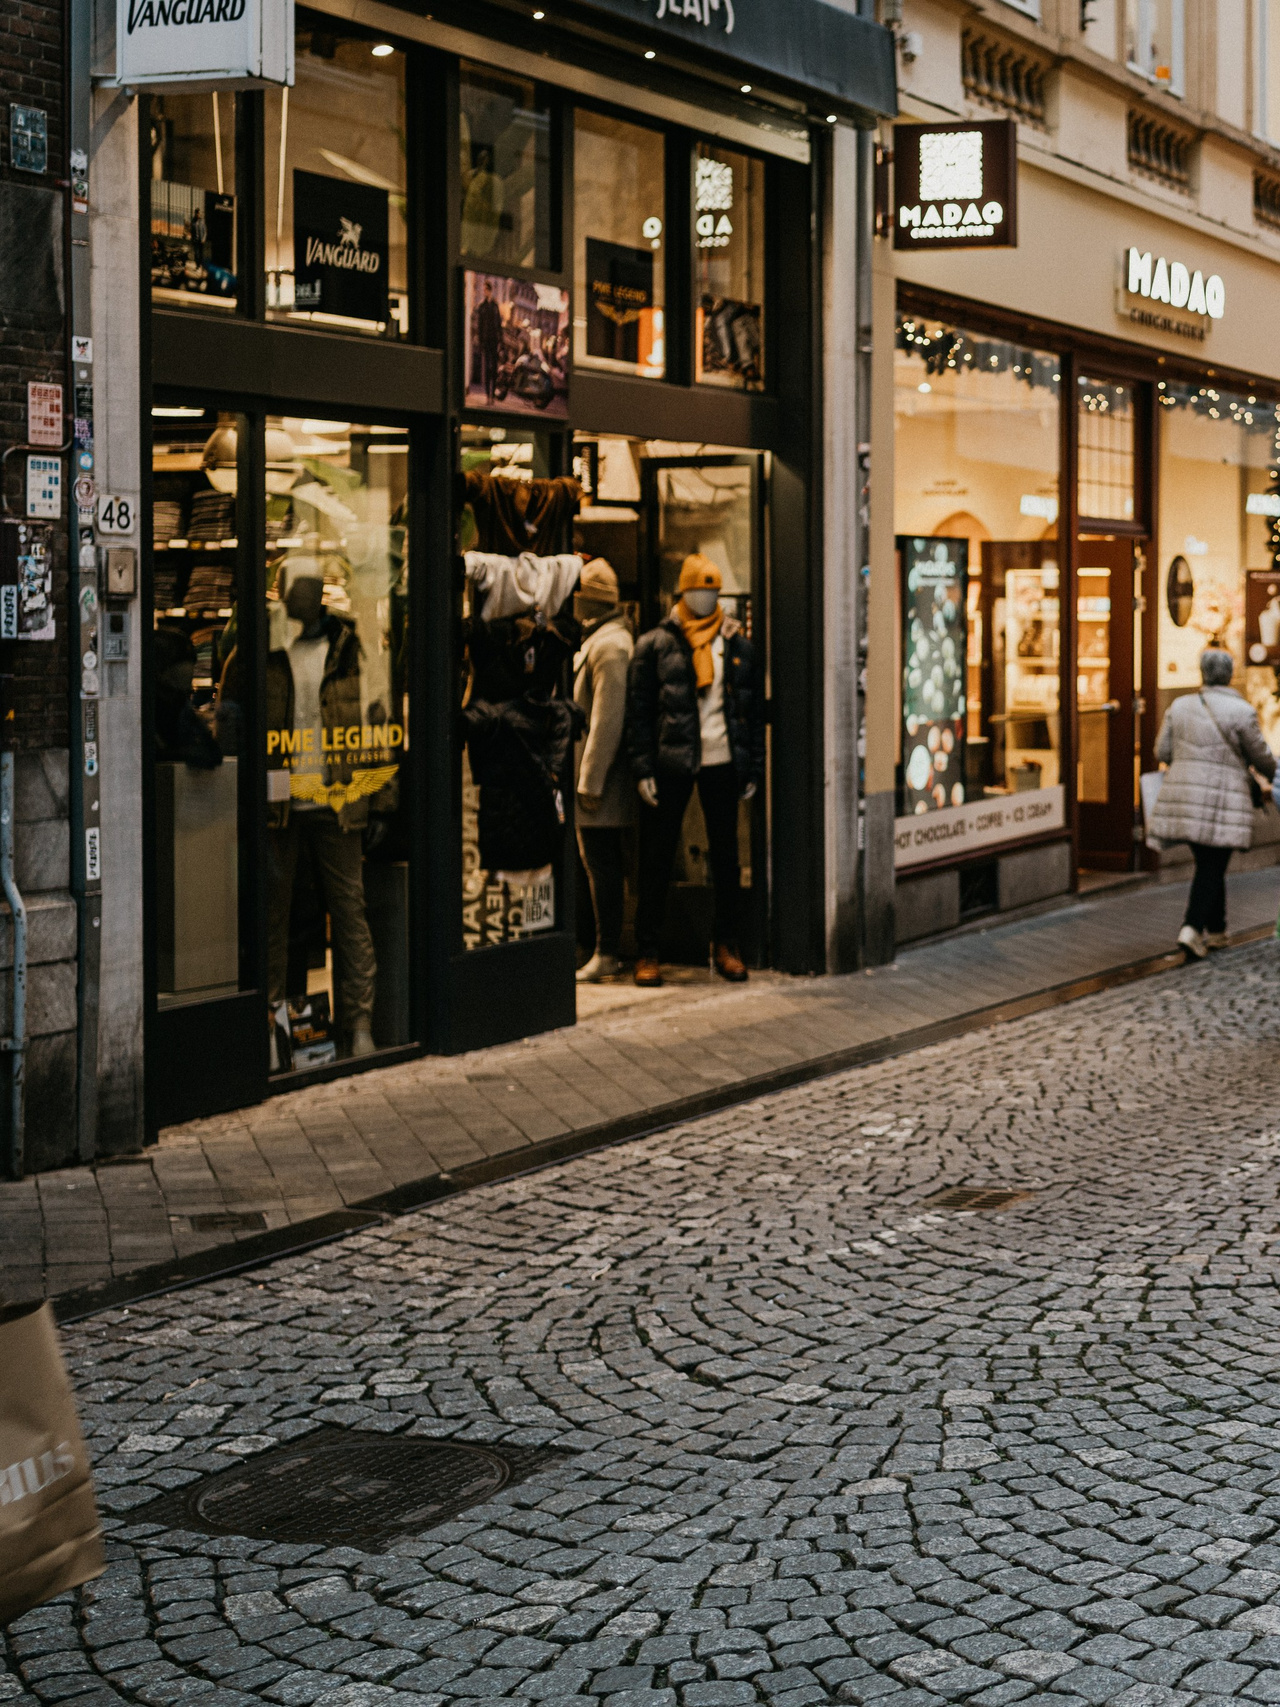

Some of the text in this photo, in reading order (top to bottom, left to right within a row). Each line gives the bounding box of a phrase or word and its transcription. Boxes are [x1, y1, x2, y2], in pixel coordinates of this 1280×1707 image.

[127, 0, 245, 35] VANGUARD
[306, 236, 379, 273] VANGUARD
[101, 500, 131, 530] 48
[266, 723, 403, 756] PME LEGEND
[914, 819, 967, 846] CHOCOLATE
